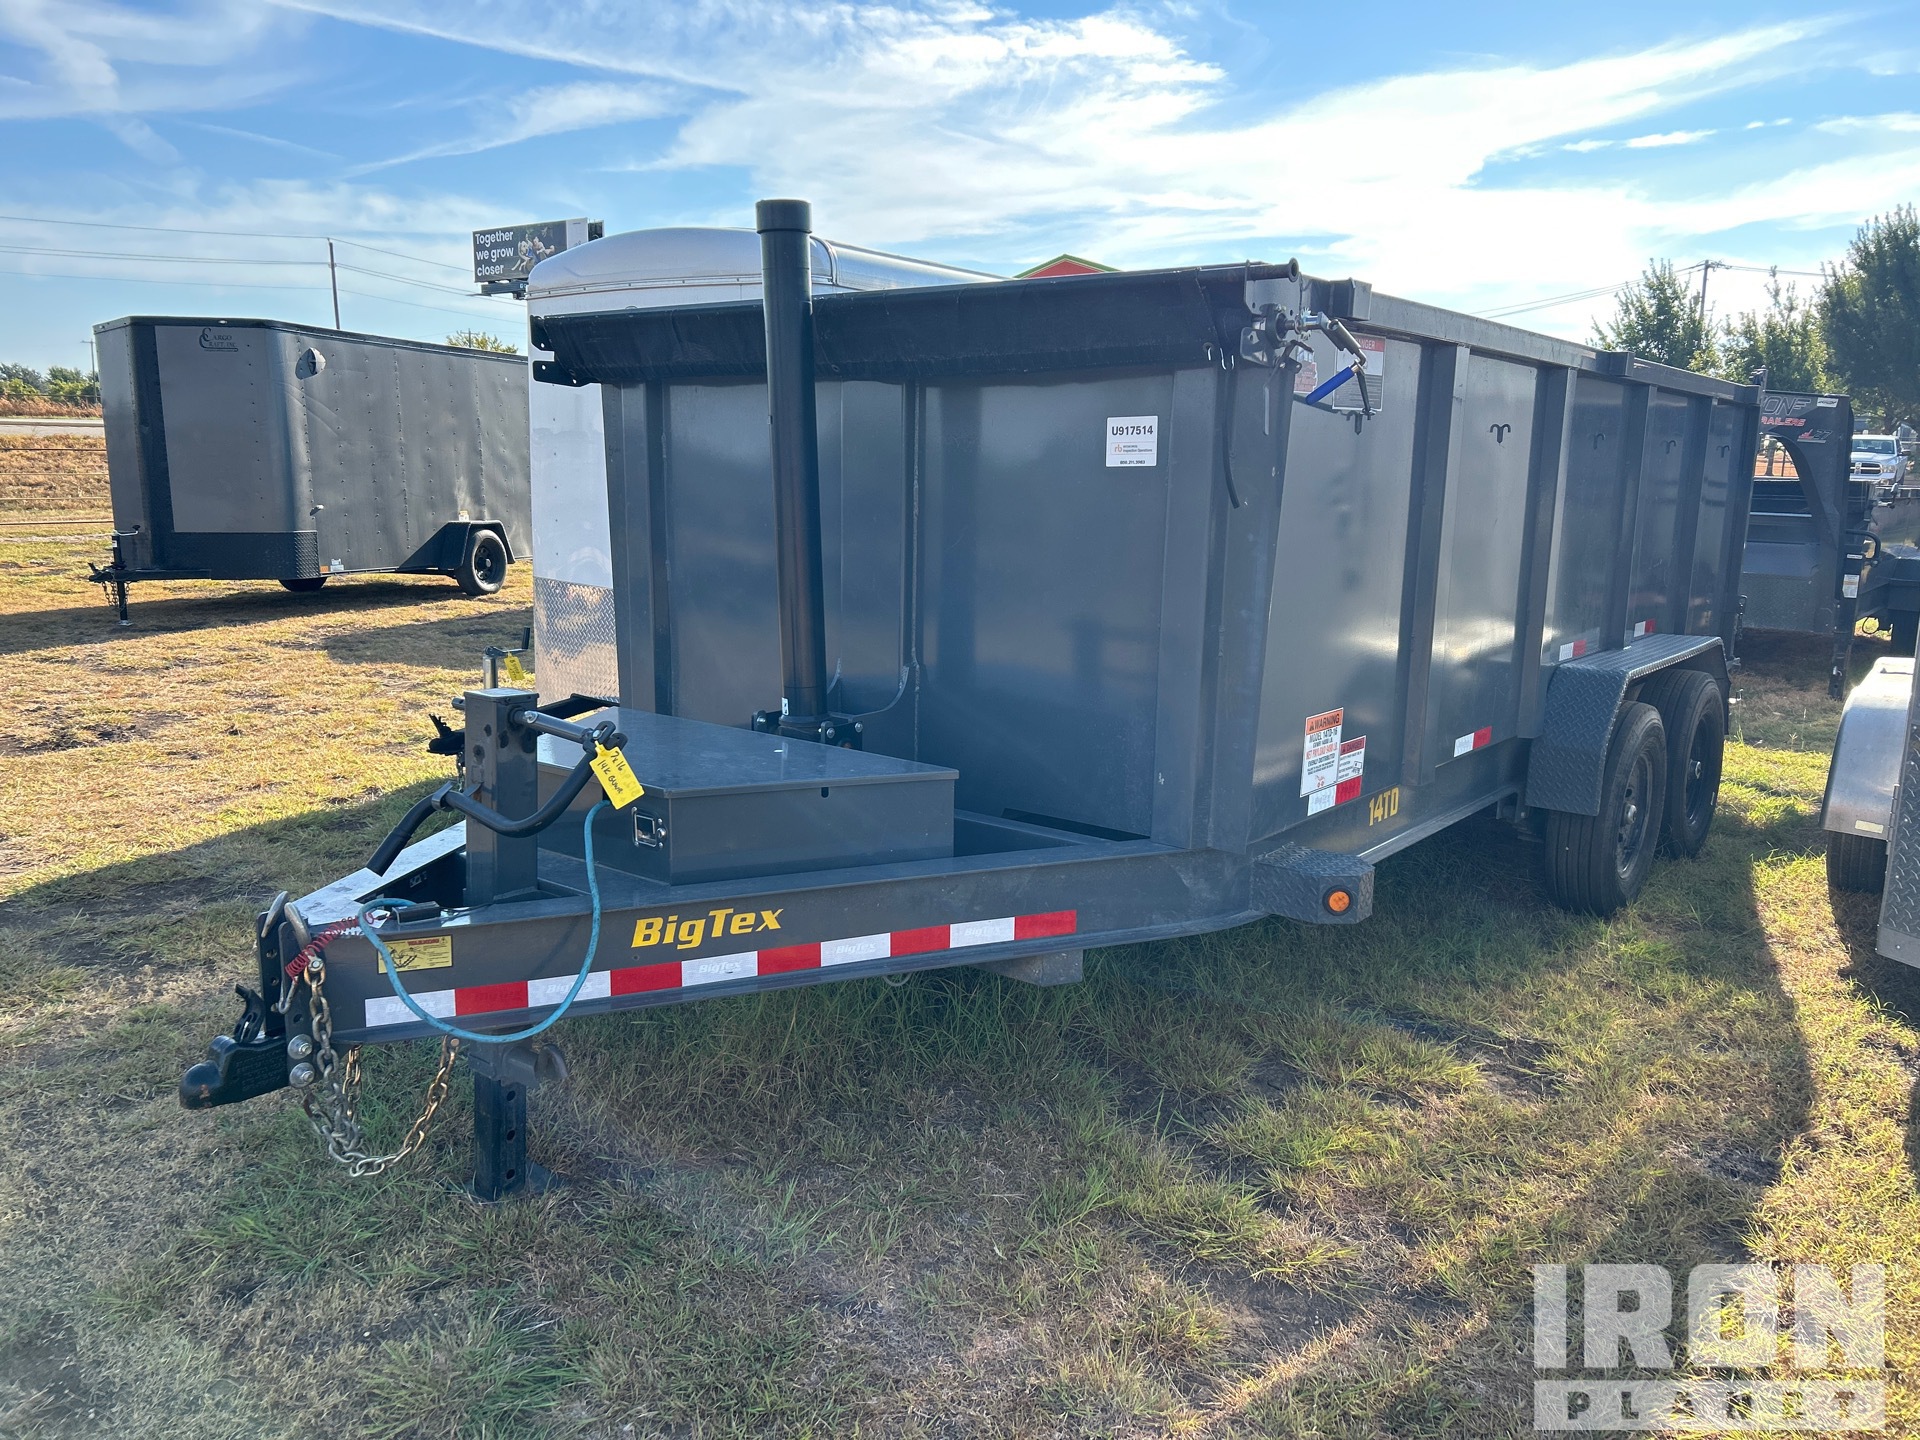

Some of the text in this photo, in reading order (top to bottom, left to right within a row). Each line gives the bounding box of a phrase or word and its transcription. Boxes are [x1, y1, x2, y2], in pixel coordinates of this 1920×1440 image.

[475, 230, 514, 248] Together
[476, 247, 514, 262] we grow
[477, 264, 505, 277] closer
[1356, 338, 1376, 350] ANGER
[1761, 416, 1807, 428] RAILERS
[1111, 425, 1154, 436] U917514
[1314, 713, 1340, 730] WARNING
[1368, 786, 1399, 827] 14TD
[630, 908, 784, 950] BigTex
[699, 961, 741, 974] BigTex
